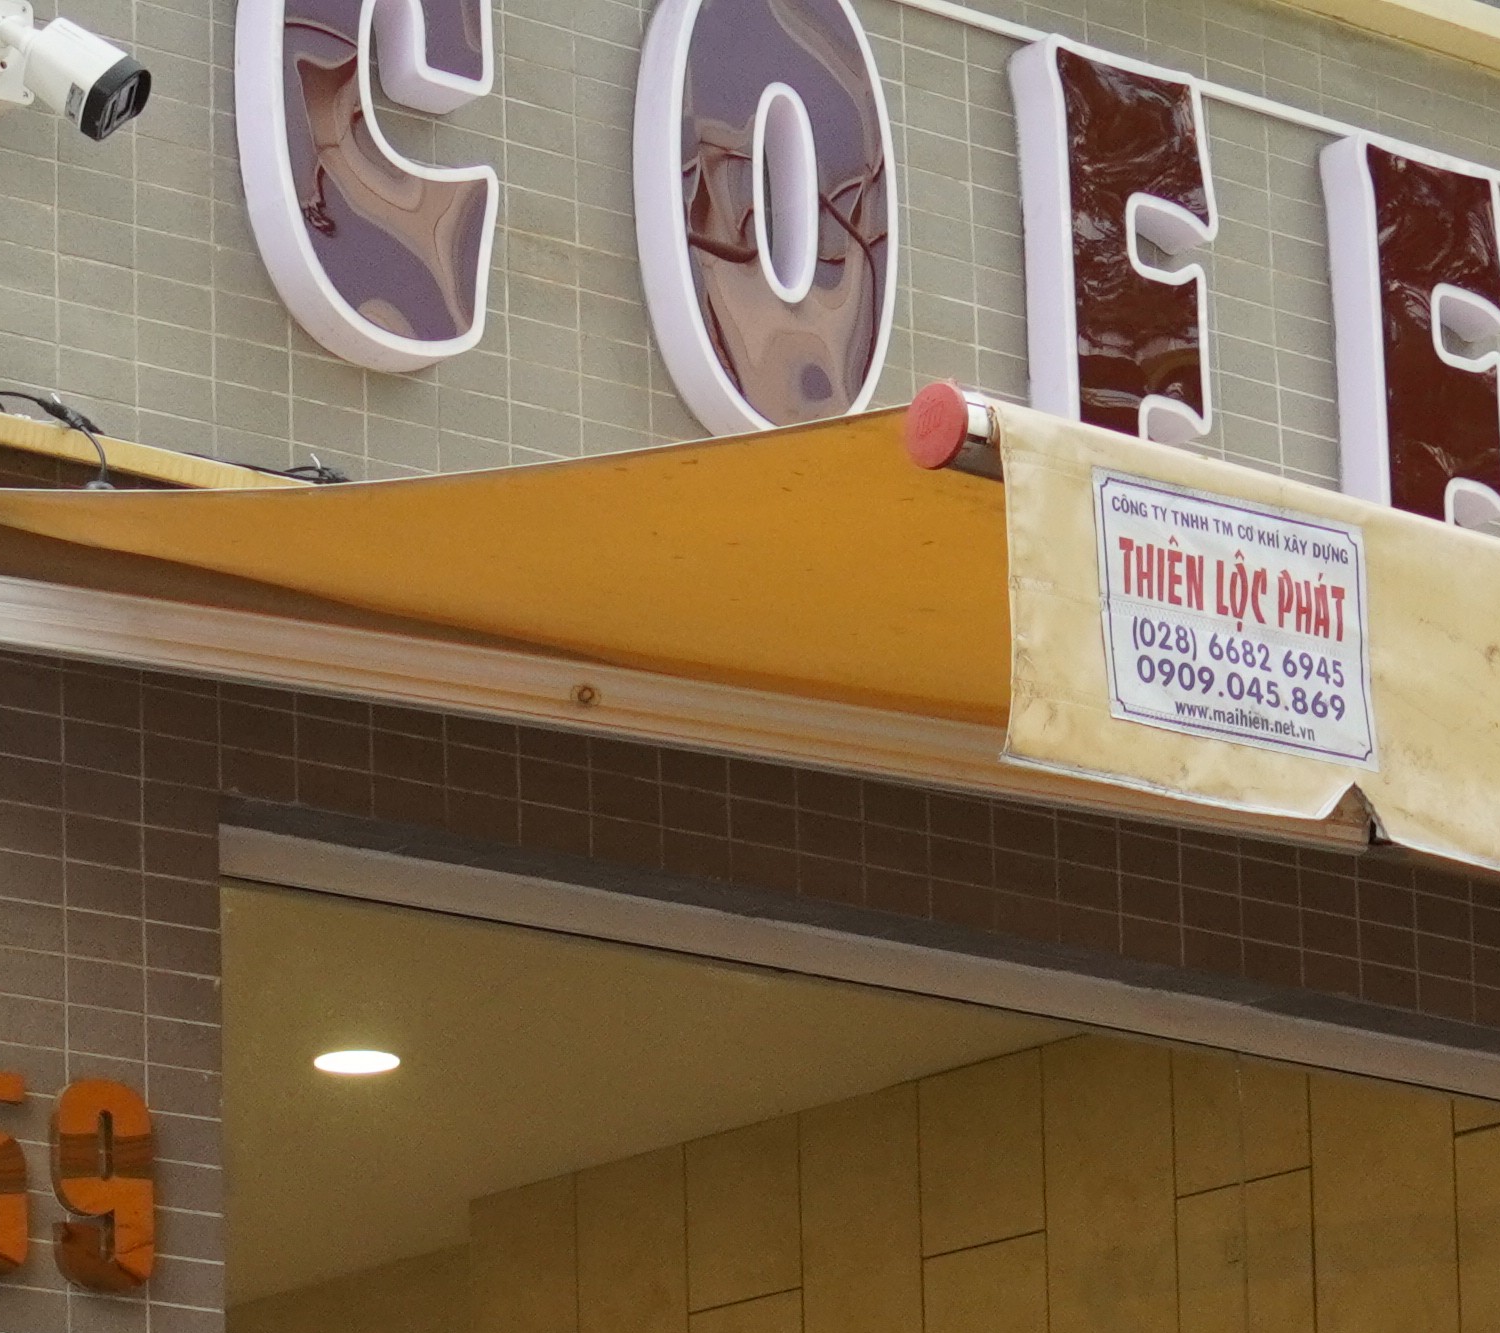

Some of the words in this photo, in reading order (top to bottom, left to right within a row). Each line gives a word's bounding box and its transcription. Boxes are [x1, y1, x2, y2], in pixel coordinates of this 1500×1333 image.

[1111, 493, 1149, 518] CÔNG
[1151, 504, 1168, 523] TY
[1171, 510, 1209, 532] TNHH
[1213, 518, 1234, 538] TM
[1237, 524, 1254, 542] CƠ
[1257, 529, 1280, 549] KHÍ
[1283, 533, 1308, 556] XÂY
[1312, 543, 1349, 565] DỰNG
[1118, 535, 1205, 612] THIÊN
[1216, 549, 1267, 633] LỘC
[1277, 572, 1346, 643] PHÁT
[1132, 616, 1198, 661] (028)
[1208, 632, 1272, 672] 6682
[1282, 650, 1345, 689] 6945
[1137, 654, 1346, 721] 0909.045.869
[1175, 701, 1316, 743] www.maihien.net.vn
